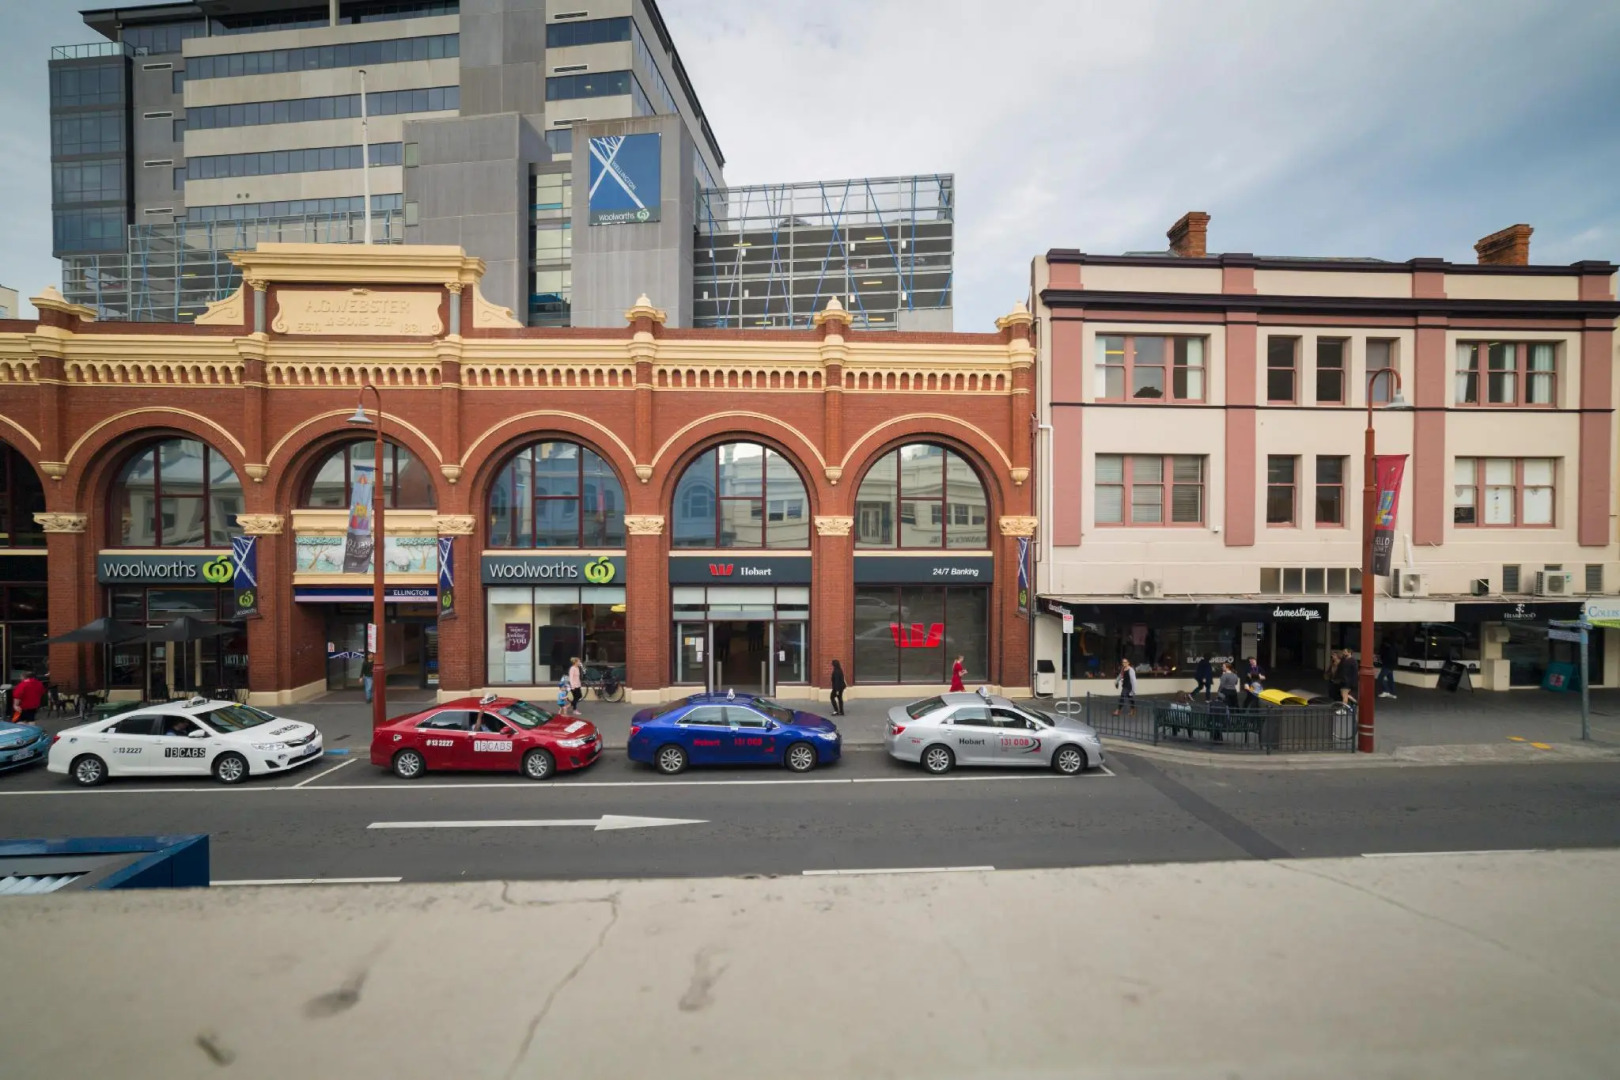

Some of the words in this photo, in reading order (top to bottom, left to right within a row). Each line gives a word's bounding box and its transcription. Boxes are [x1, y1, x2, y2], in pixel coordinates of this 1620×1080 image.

[611, 160, 637, 191] WELLINGTON
[103, 560, 197, 577] Woolworths
[489, 560, 578, 578] Woolworths
[740, 566, 772, 576] Hobart
[932, 567, 950, 576] 24/7
[951, 567, 979, 577] Banking
[1273, 606, 1321, 620] domestique
[511, 638, 527, 646] you
[438, 739, 454, 747] 2227
[474, 740, 513, 752] 13CABS
[958, 737, 986, 746] Hobart
[1000, 738, 1012, 747] 131
[1013, 738, 1029, 747] 008
[164, 747, 206, 758] 13CABS
